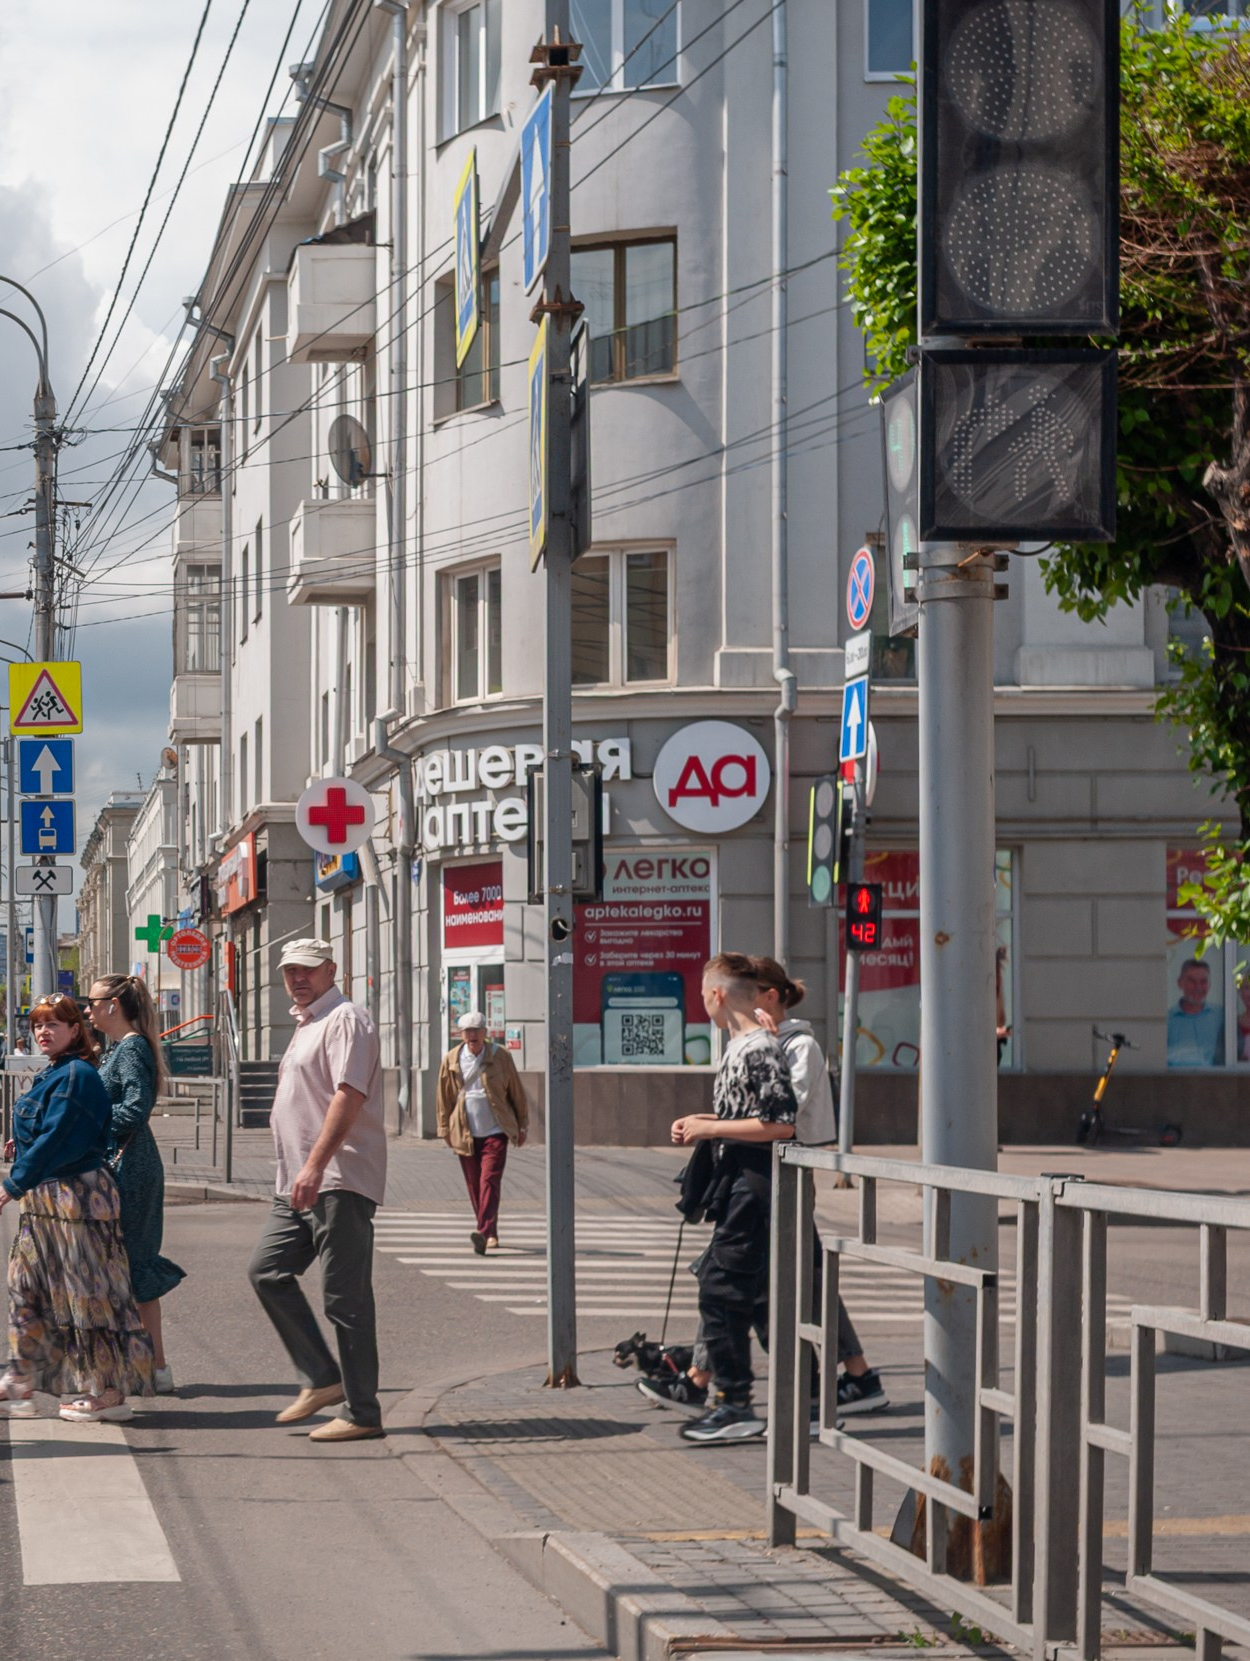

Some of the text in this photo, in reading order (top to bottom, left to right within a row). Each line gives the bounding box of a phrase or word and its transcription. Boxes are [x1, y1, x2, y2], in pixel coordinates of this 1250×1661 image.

[613, 857, 710, 880] легко
[453, 885, 502, 906] Более 7000
[584, 904, 702, 920] aptekalegko.ru
[851, 923, 876, 943] 42
